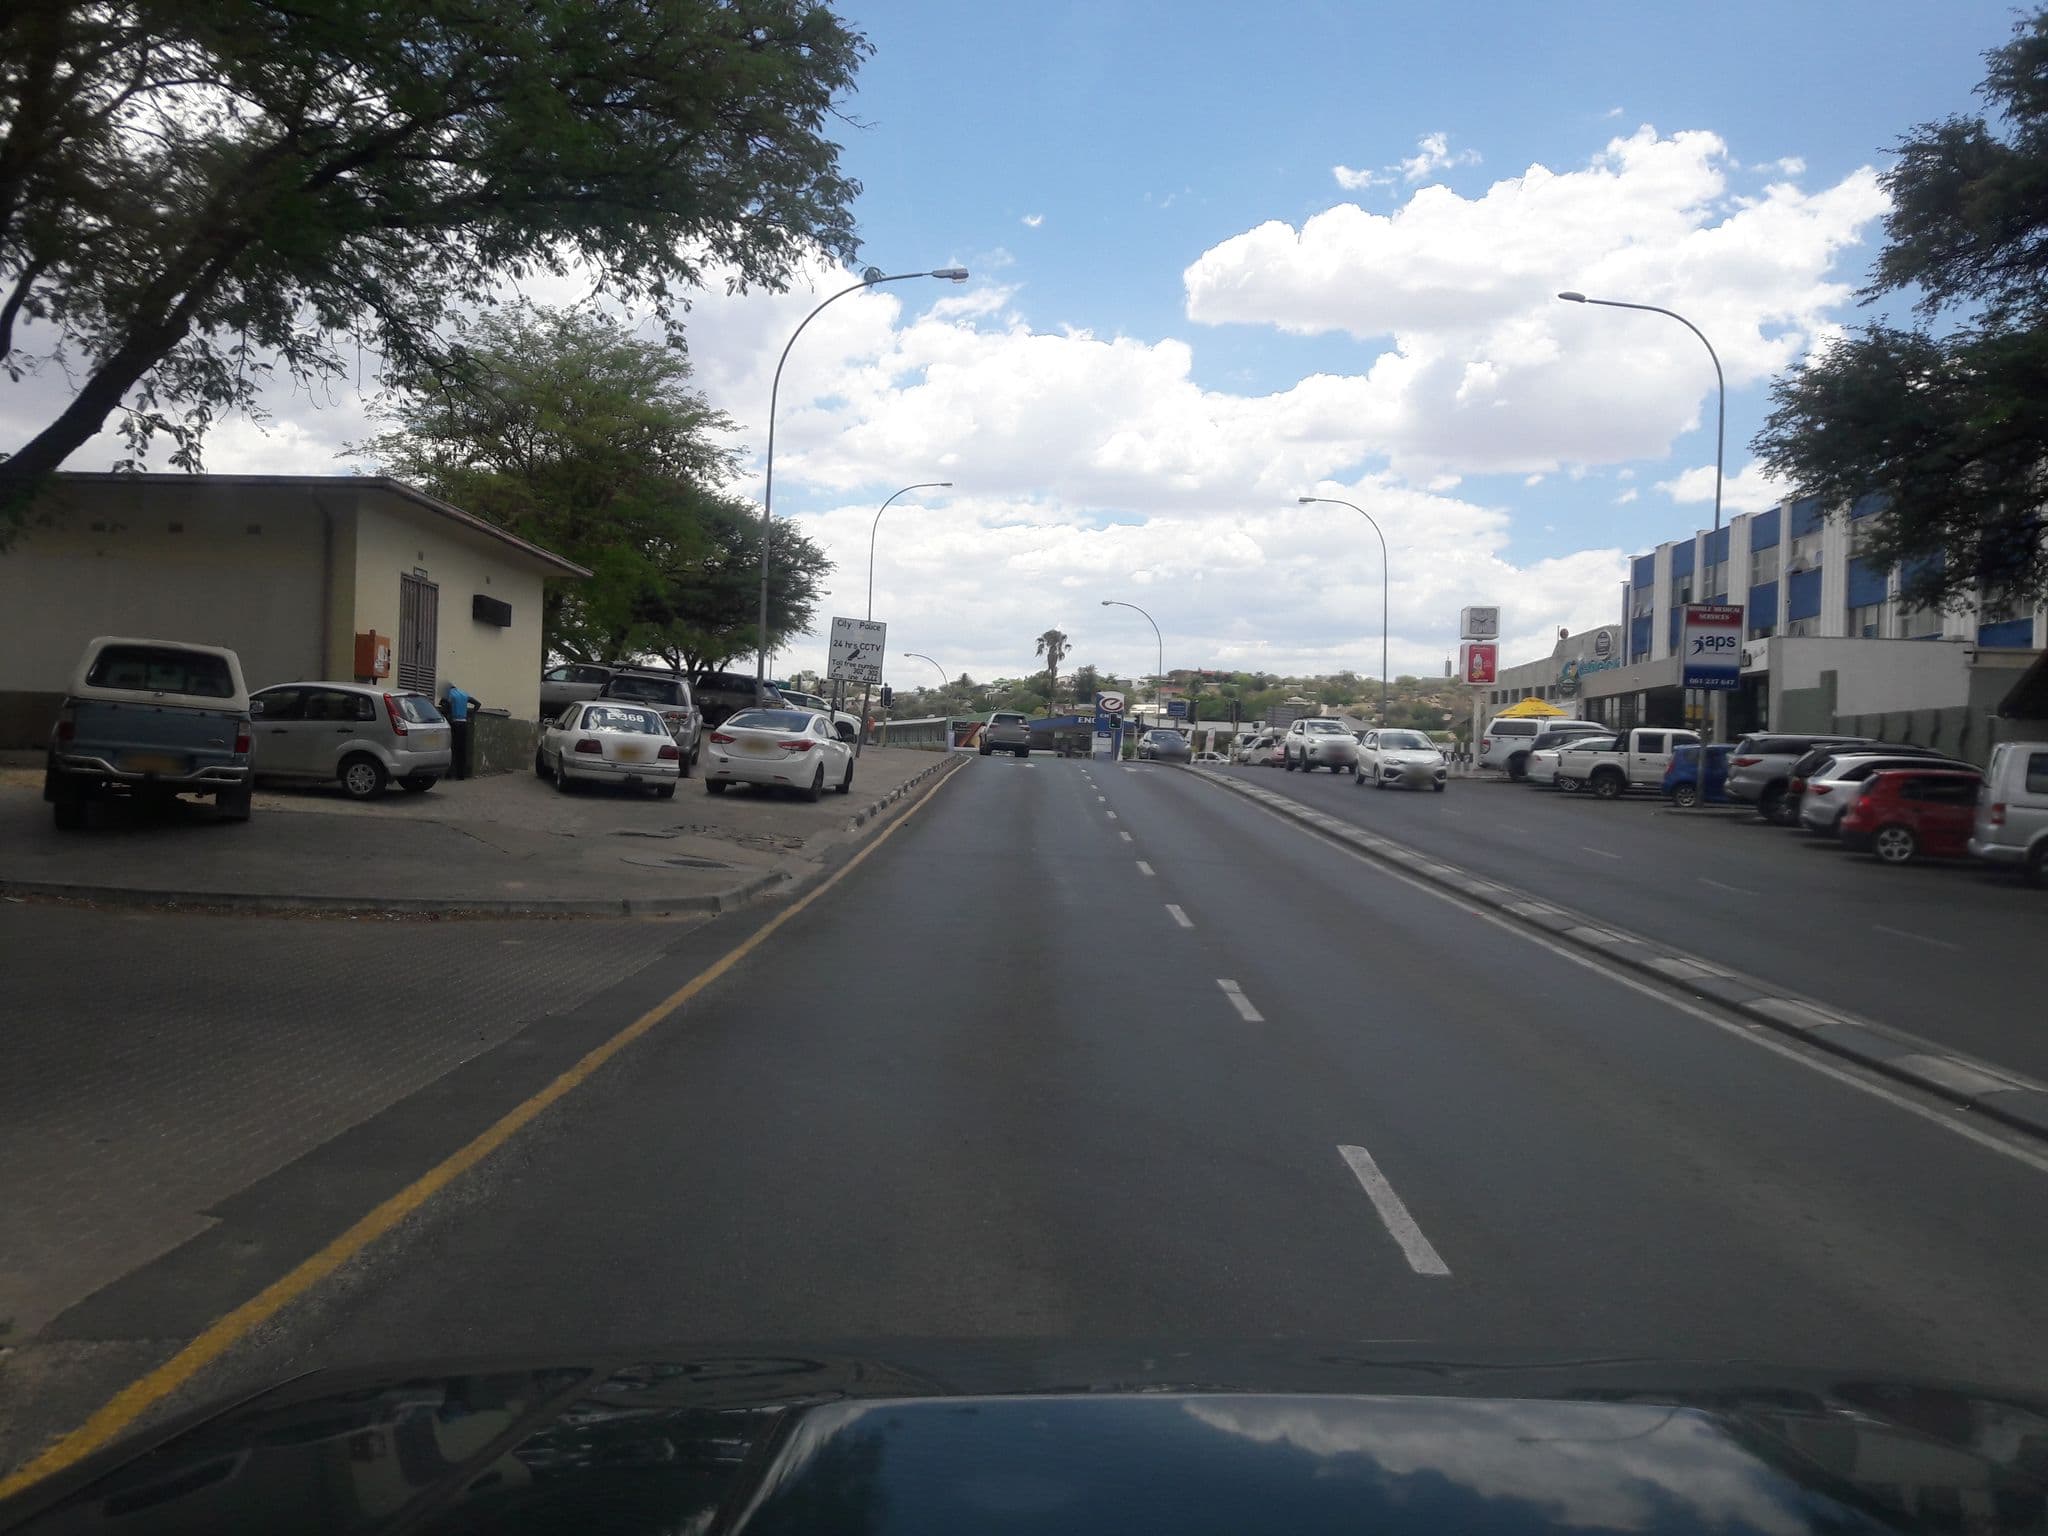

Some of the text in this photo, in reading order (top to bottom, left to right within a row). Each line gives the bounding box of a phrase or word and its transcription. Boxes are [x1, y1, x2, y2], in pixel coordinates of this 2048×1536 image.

[837, 619, 881, 631] City Police
[859, 642, 881, 651] CCTV
[1705, 635, 1736, 651] aps
